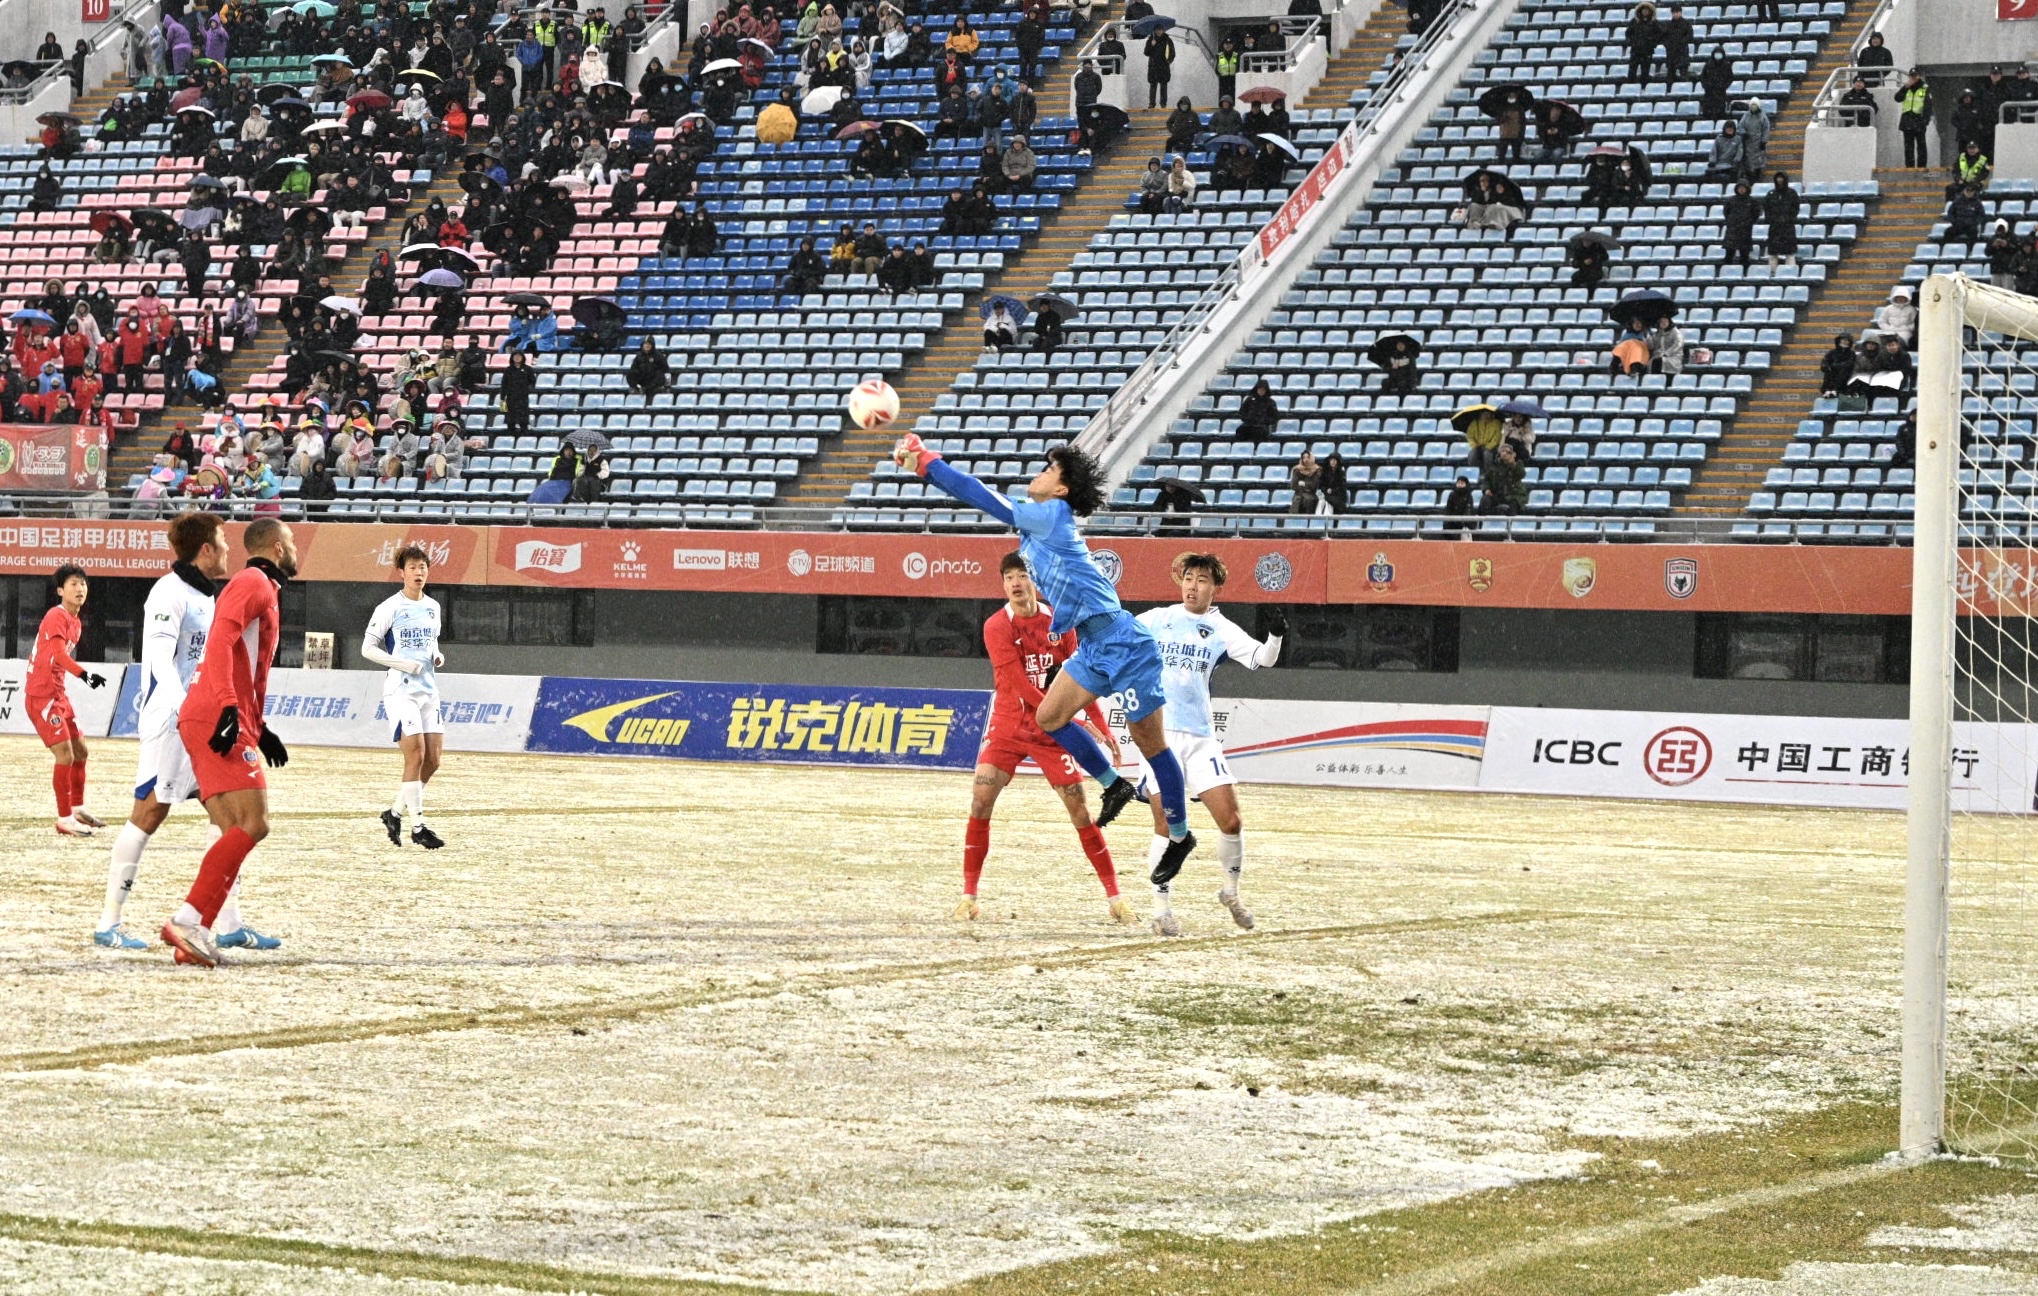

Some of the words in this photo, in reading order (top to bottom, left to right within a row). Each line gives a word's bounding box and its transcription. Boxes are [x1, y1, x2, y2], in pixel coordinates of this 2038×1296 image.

[0, 527, 171, 551] 中国足球甲级联赛
[73, 557, 124, 569] FOOTBALL
[613, 563, 647, 572] KELME
[678, 553, 721, 565] Lenovo
[727, 551, 760, 569] 联想
[814, 555, 875, 573] 足球频道
[930, 557, 982, 578] photo
[726, 697, 955, 756] 锐克体育
[1532, 737, 1622, 766] ICBC
